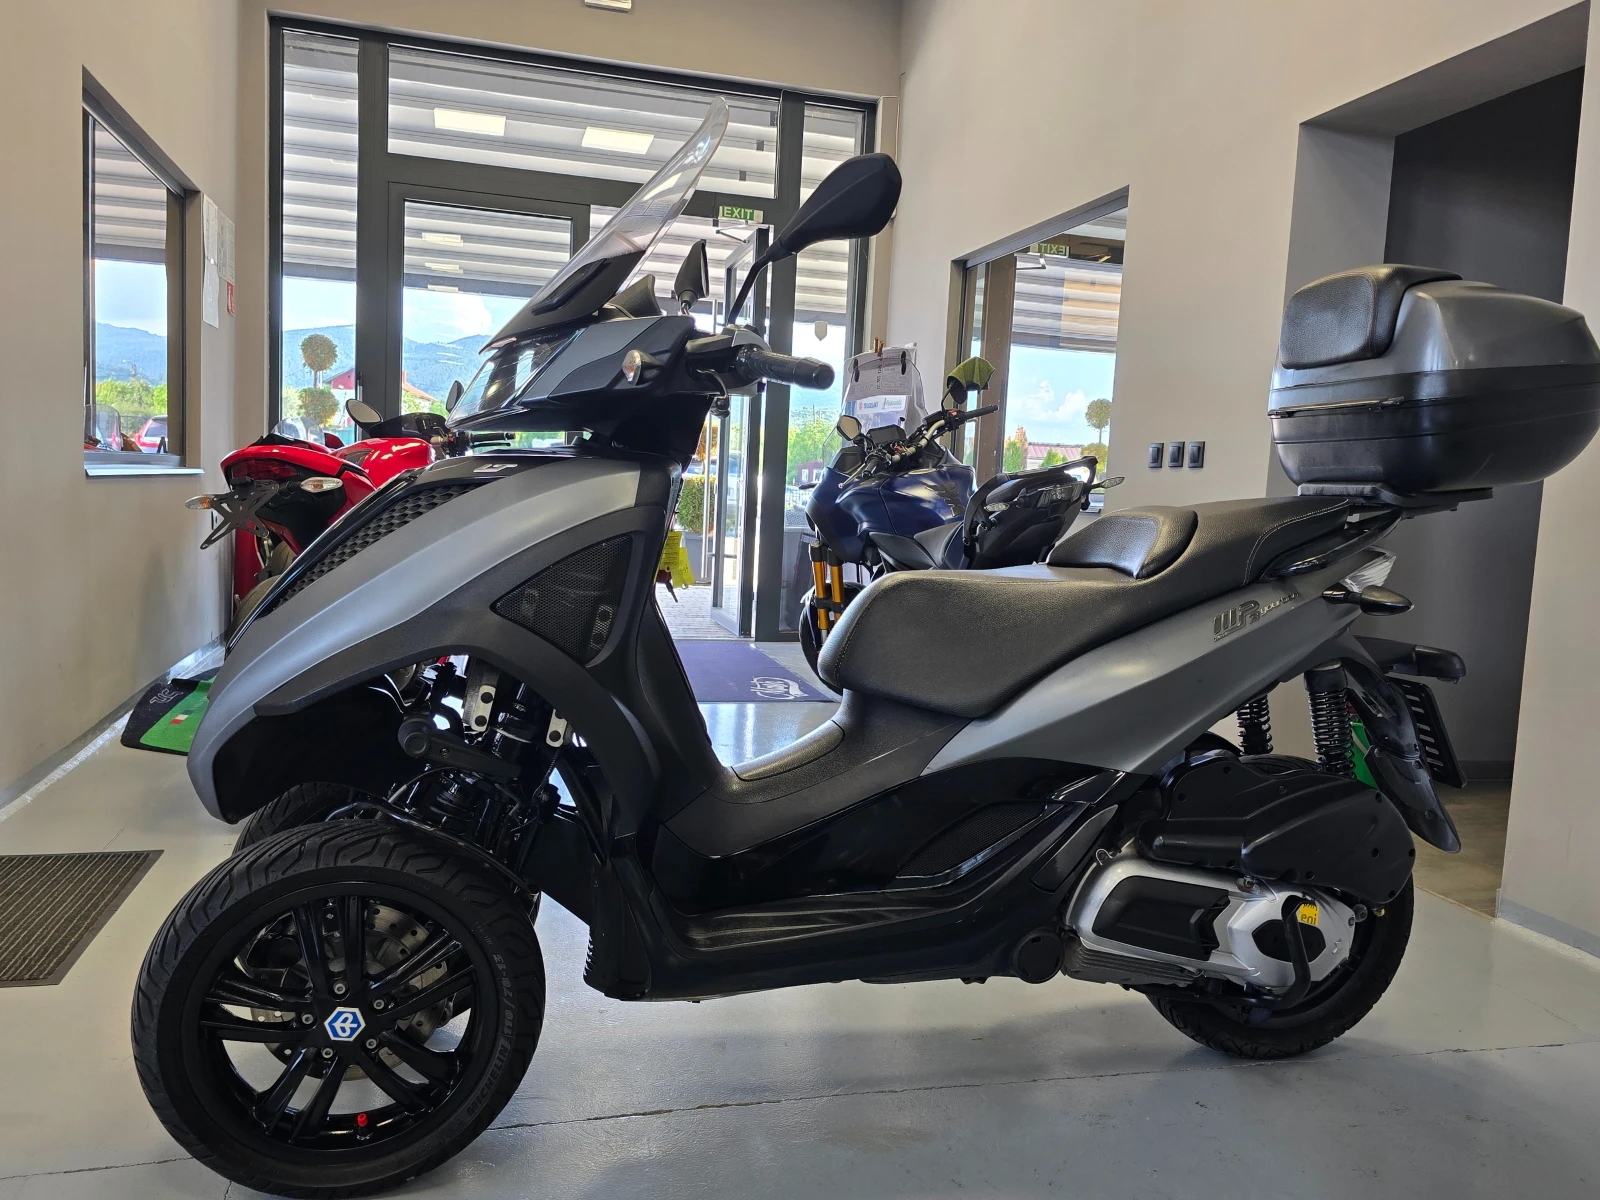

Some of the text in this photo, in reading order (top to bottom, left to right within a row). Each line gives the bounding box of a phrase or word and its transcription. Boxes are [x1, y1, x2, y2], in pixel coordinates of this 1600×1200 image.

[723, 206, 752, 220] EXIT
[1300, 913, 1317, 925] eni
[466, 1045, 509, 1117] MICHELIN
